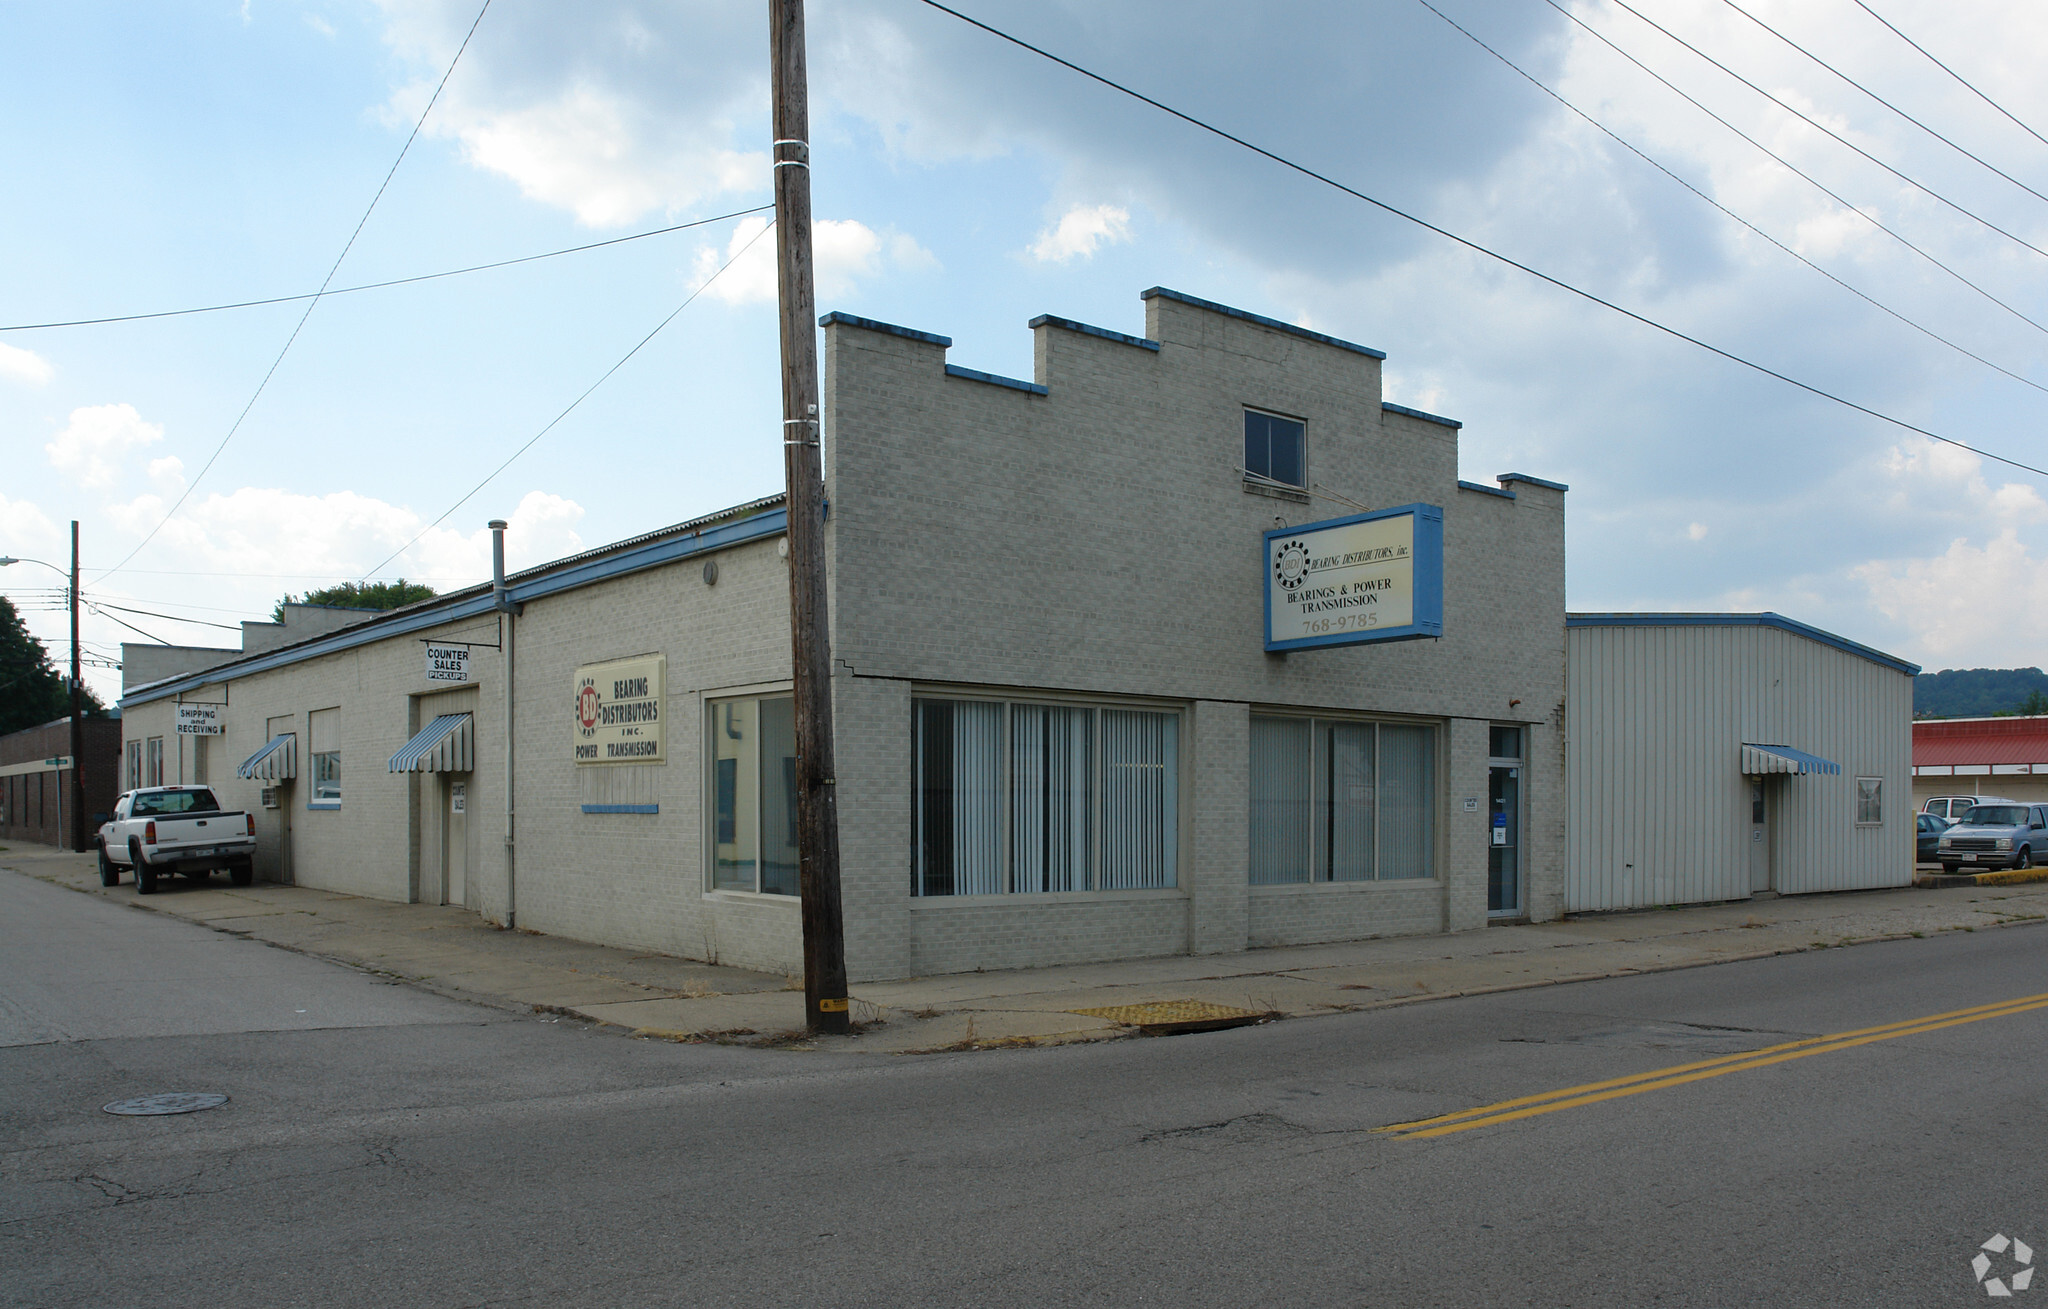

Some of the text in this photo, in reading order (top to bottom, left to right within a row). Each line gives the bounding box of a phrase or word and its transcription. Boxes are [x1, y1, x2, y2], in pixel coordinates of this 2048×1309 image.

[1285, 558, 1300, 570] BDI
[1311, 555, 1341, 570] BEARING
[1287, 578, 1392, 604] BEARINGS & POWER
[1301, 593, 1378, 614] TRANSMISSION
[1302, 612, 1378, 634] 768-9785
[427, 648, 469, 661] COUNTER
[434, 660, 462, 671] SALES
[429, 671, 466, 680] PICKUPS
[614, 677, 648, 699] BEARING
[180, 709, 216, 719] SHIPPING
[602, 700, 658, 725] DISTRIBUTORS
[177, 724, 218, 734] RECEIVING
[621, 727, 644, 737] INC.
[575, 741, 657, 759] POWER TRANSMISSION
